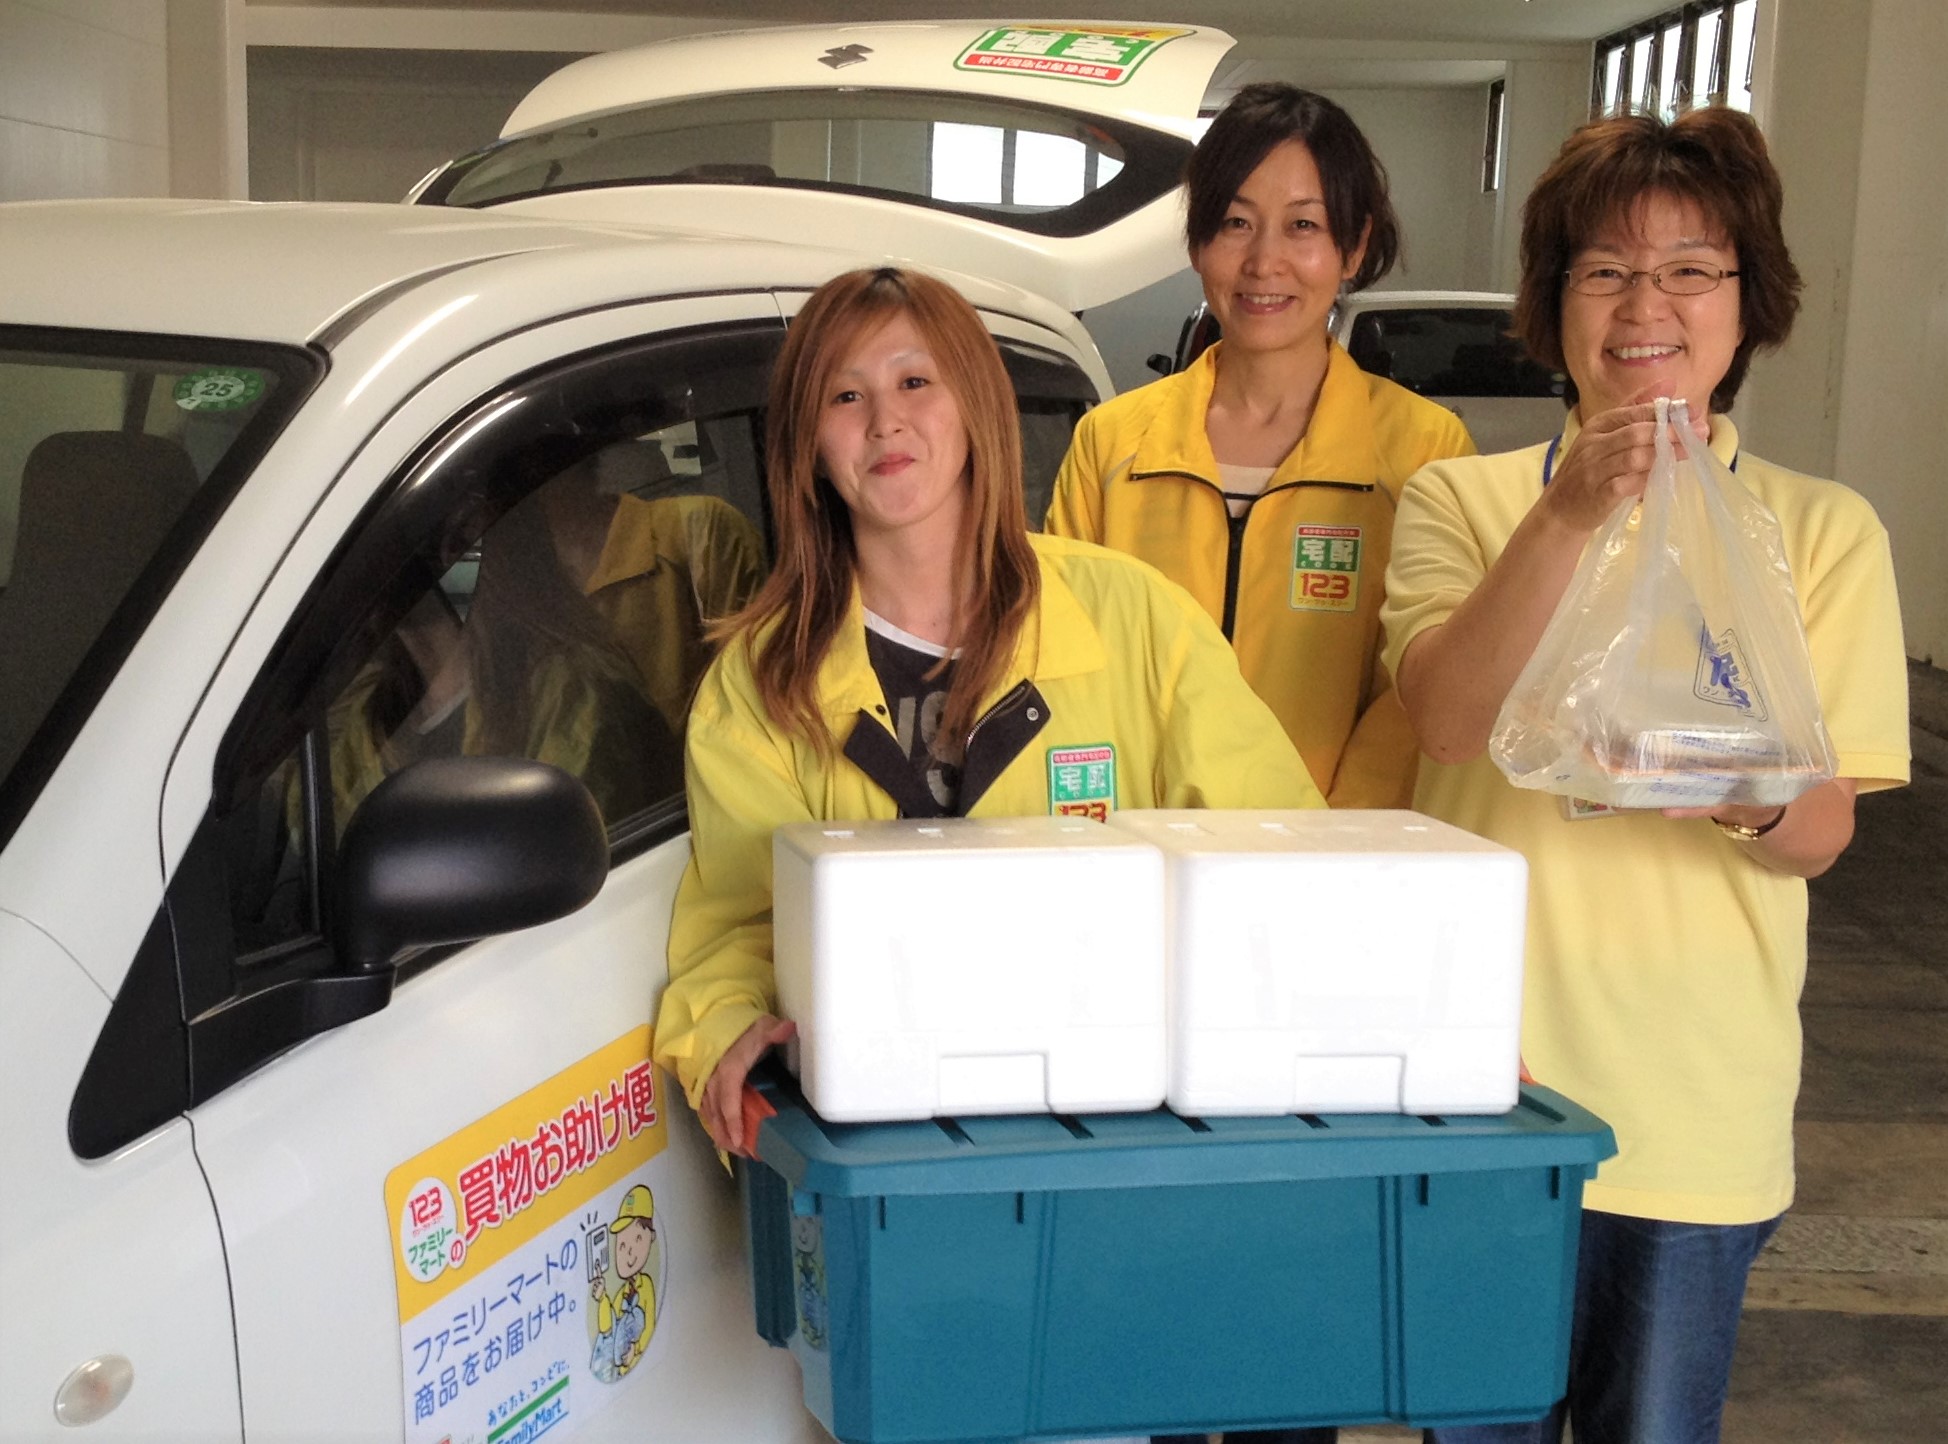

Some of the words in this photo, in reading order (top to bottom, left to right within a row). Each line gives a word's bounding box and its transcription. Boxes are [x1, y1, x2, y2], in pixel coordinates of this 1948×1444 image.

[200, 382, 234, 397] 25
[1301, 573, 1351, 600] 123
[460, 1060, 656, 1240] 買物お助け便
[408, 1186, 443, 1228] 123
[408, 1227, 454, 1264] ファミリー
[419, 1250, 446, 1276] マート
[413, 1238, 578, 1375] ファミリーマートの
[414, 1291, 577, 1426] 商品をお届け中。
